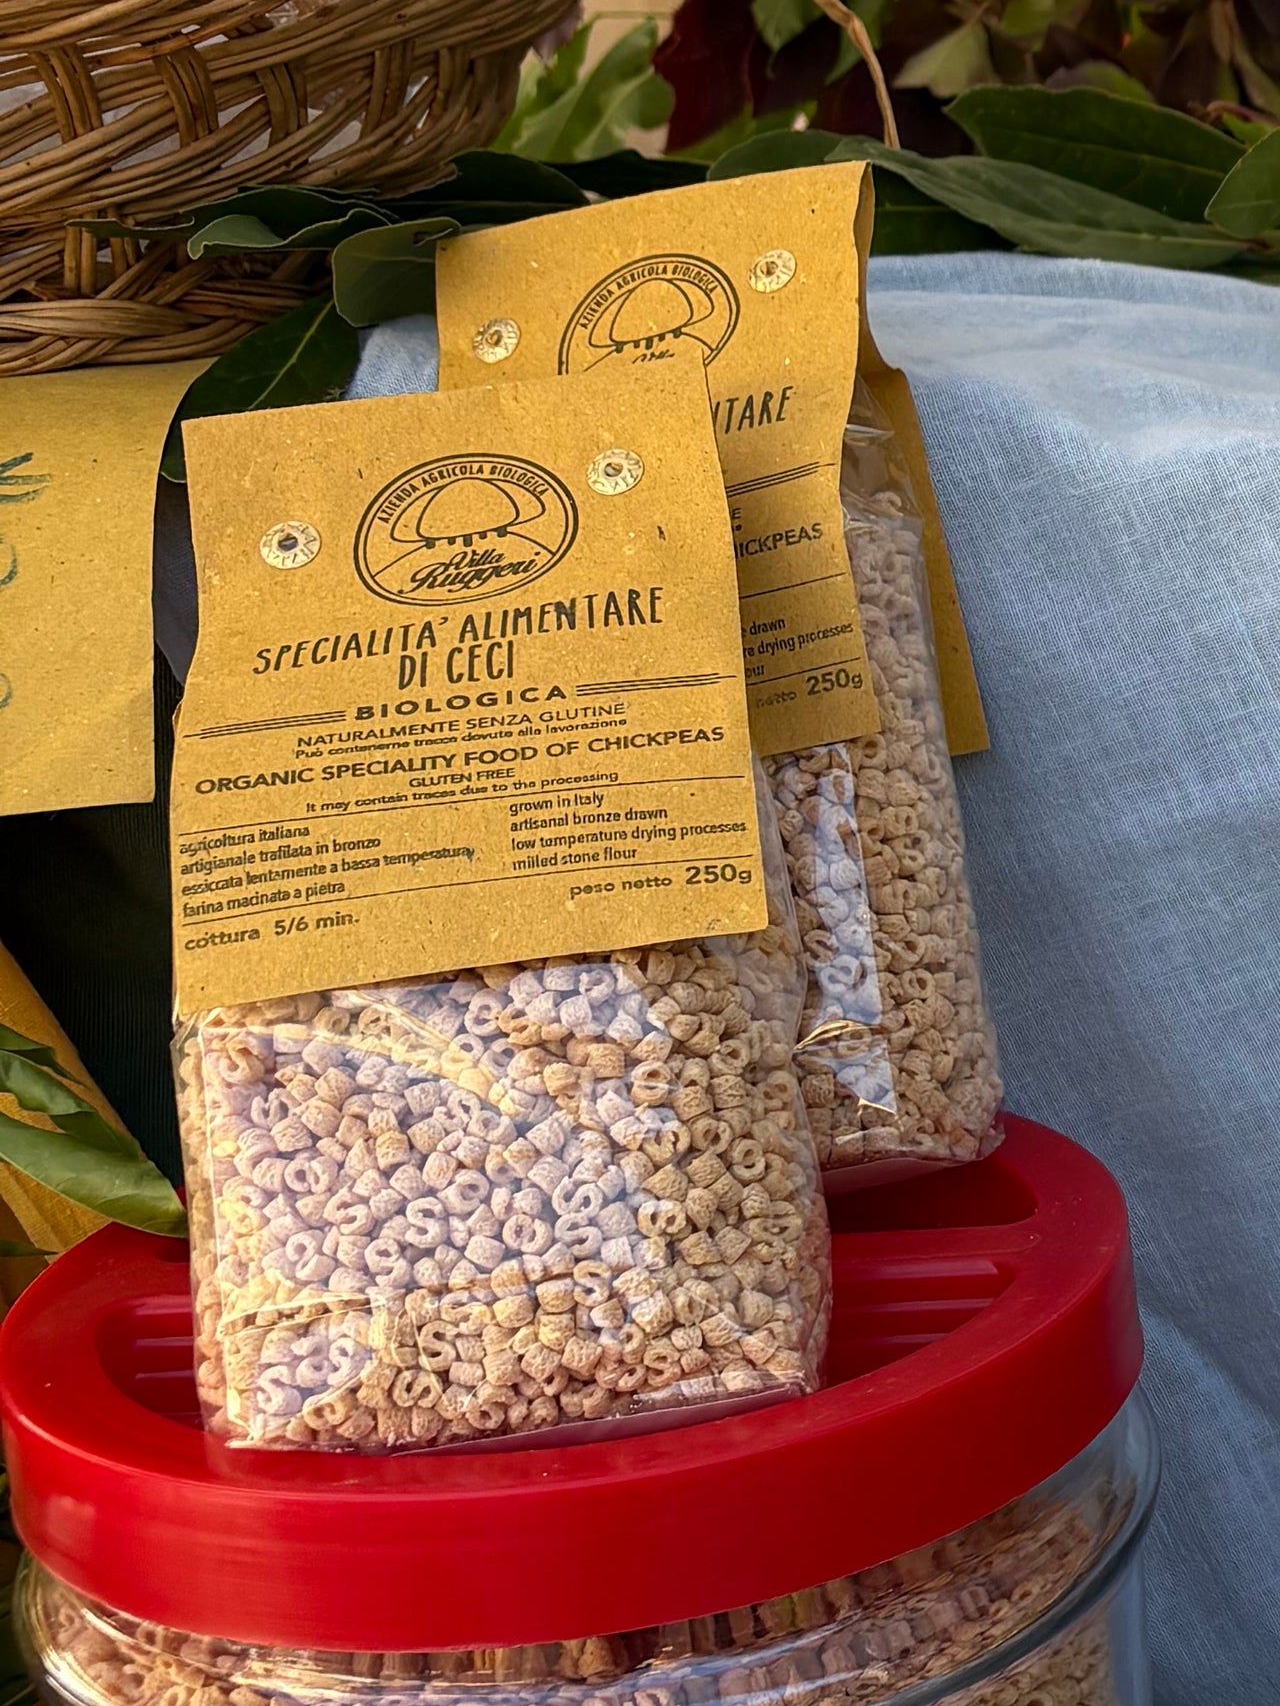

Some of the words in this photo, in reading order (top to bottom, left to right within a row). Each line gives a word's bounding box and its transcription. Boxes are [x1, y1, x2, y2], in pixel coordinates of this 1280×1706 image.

[397, 552, 541, 593] Ruggeri
[444, 548, 505, 570] Villa
[252, 616, 449, 675] SPECIALITA'
[458, 587, 663, 644] ALIMENTARE
[398, 651, 428, 690] DI
[446, 640, 514, 684] CECI
[805, 667, 863, 697] 250g
[355, 685, 567, 721] BIOLOGICA
[297, 719, 460, 748] NATURALMENTE
[466, 713, 538, 730] SENZA
[539, 703, 626, 722] GLUTINE
[195, 767, 315, 795] ORGANIC
[321, 753, 457, 781] SPECIALITY
[463, 746, 538, 766] FOOD
[546, 742, 580, 756] OF
[587, 726, 725, 753] CHICKPEAS
[409, 772, 472, 788] GLUTEN
[475, 768, 516, 781] FREE
[570, 881, 615, 900] peso
[621, 876, 673, 891] netto
[685, 863, 753, 886] 250g
[184, 927, 260, 951] cottura
[274, 917, 309, 936] 5/6
[316, 912, 360, 930] min.
